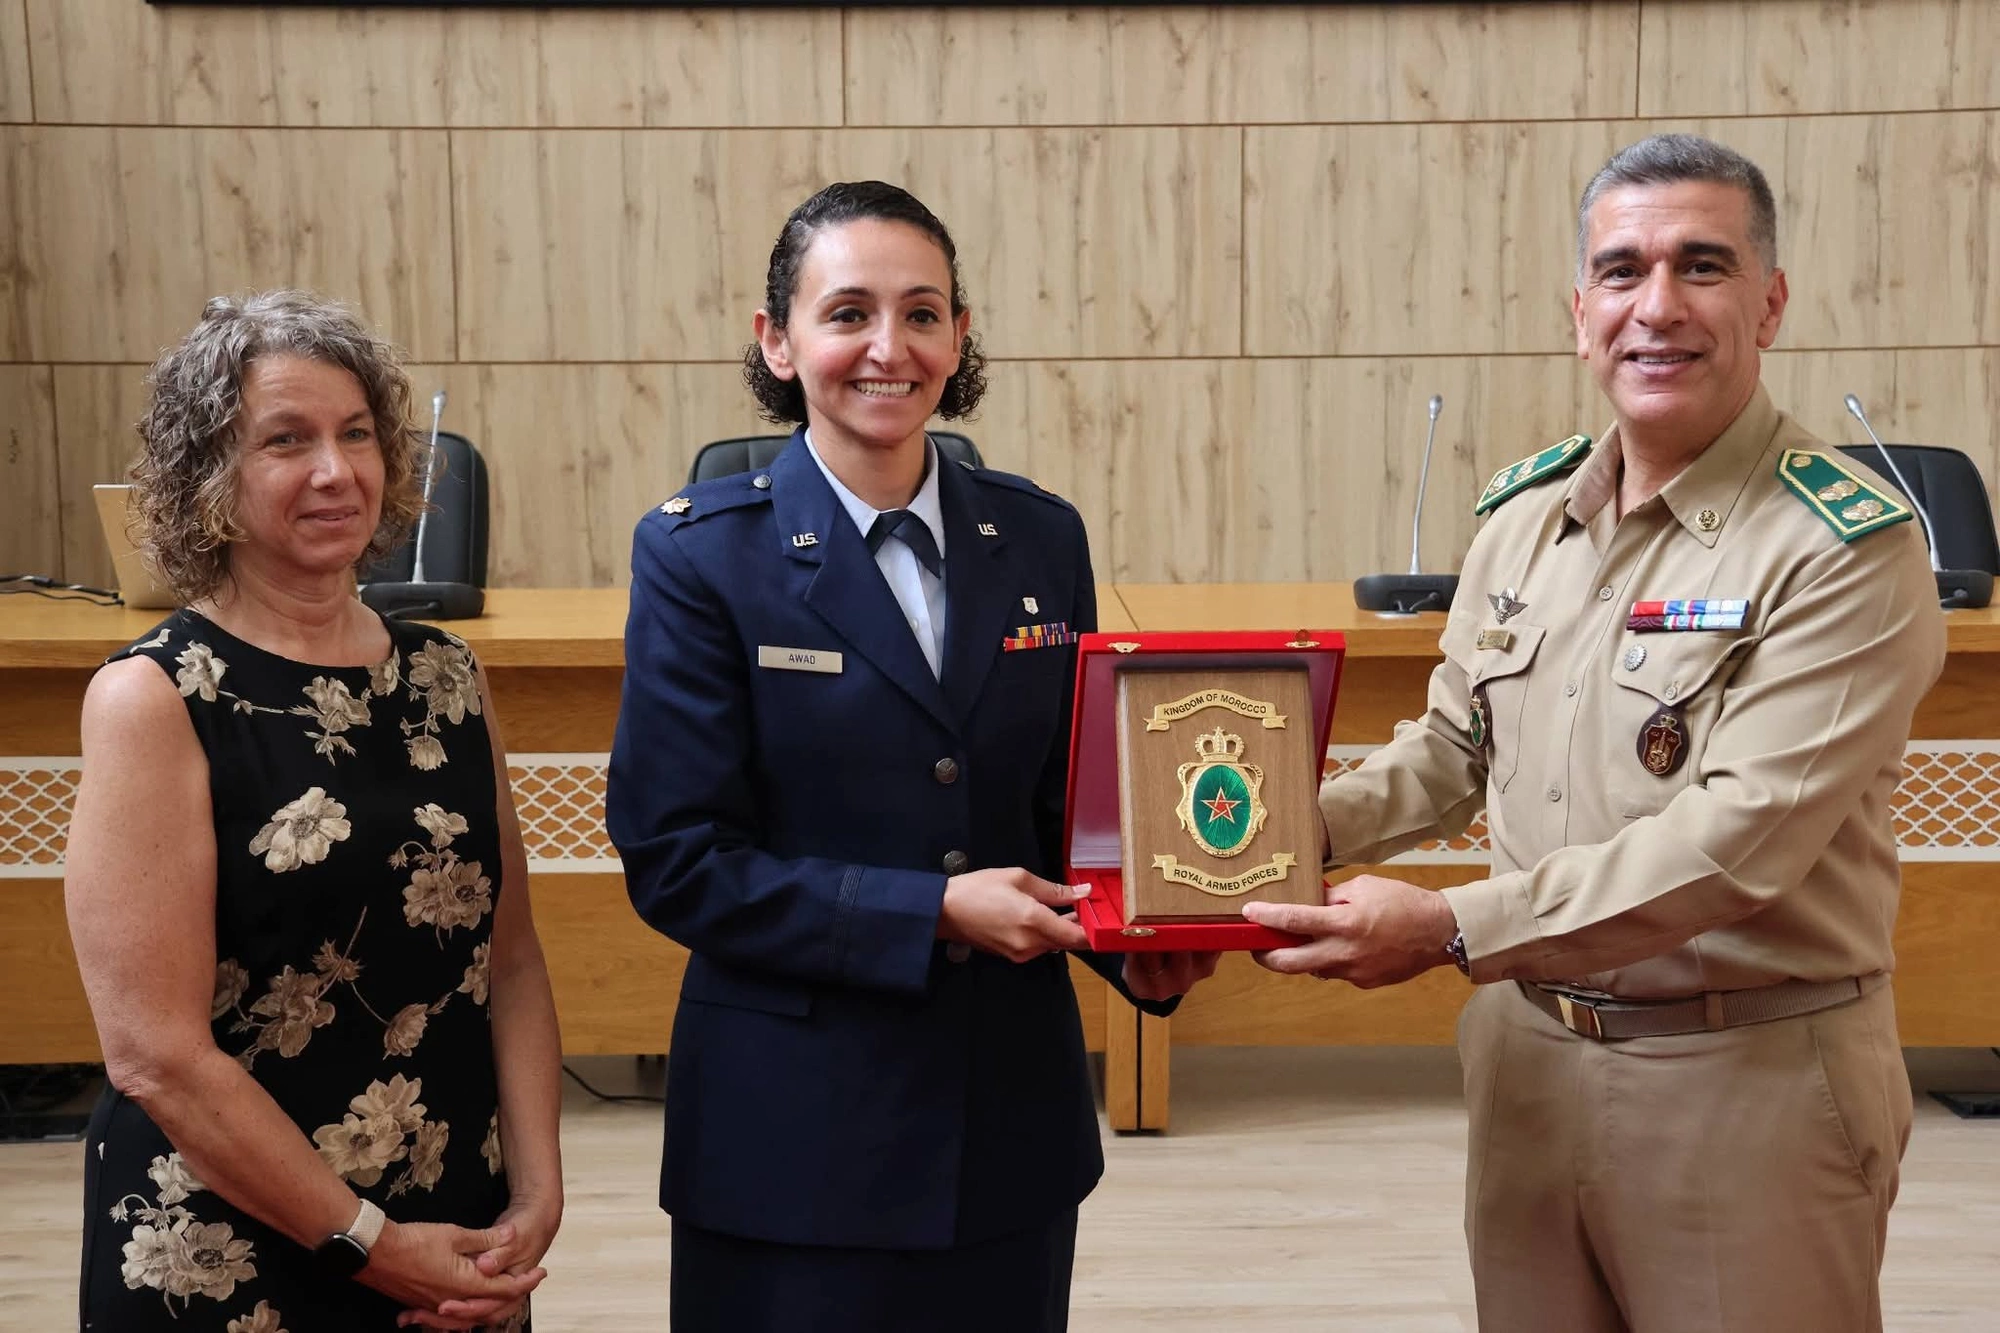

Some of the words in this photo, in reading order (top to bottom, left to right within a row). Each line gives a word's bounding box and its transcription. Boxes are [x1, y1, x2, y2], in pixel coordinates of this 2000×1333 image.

[792, 532, 819, 547] U.S.
[788, 654, 816, 665] AWAD
[1163, 696, 1205, 716] KINGDOM
[1206, 693, 1218, 702] OF
[1220, 694, 1267, 714] MOROCCO
[1173, 869, 1203, 885] ROYAL
[1206, 880, 1240, 891] ARMED
[1242, 867, 1278, 887] FORCES
